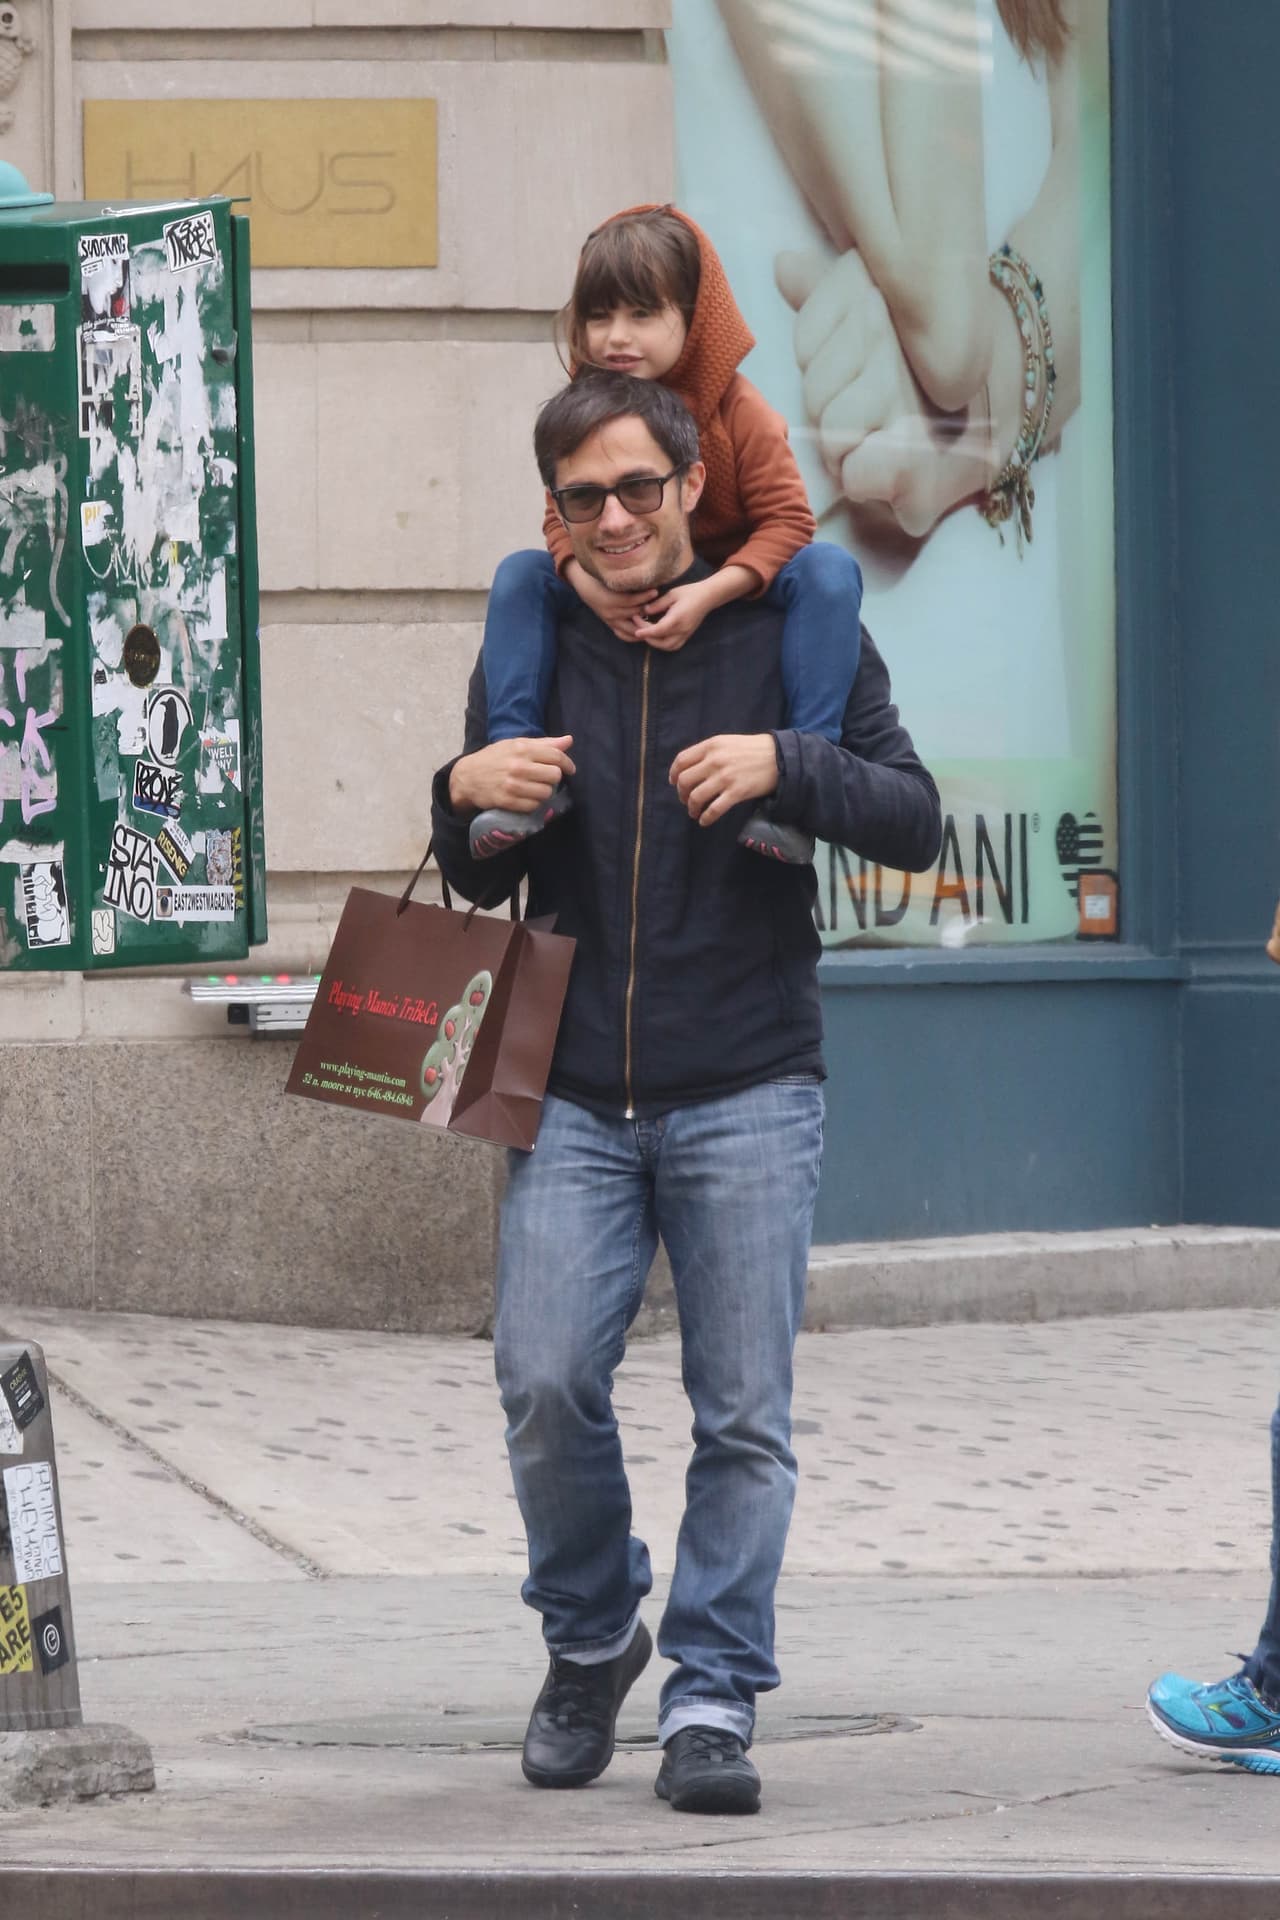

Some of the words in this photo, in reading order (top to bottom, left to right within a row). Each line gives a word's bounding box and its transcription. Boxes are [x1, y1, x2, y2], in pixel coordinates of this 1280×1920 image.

[126, 151, 397, 216] HAUS
[811, 846, 911, 931] ND
[929, 813, 1029, 925] ANI
[174, 892, 234, 911] EAST2WESTMAGAZINE
[328, 981, 363, 1015] Playing
[367, 990, 399, 1017] Mantis
[399, 997, 438, 1025] TriBeCa
[320, 1062, 406, 1087] www.playing-mantis.com
[320, 1079, 344, 1092] moore
[345, 1084, 353, 1093] st
[353, 1087, 366, 1098] nyc
